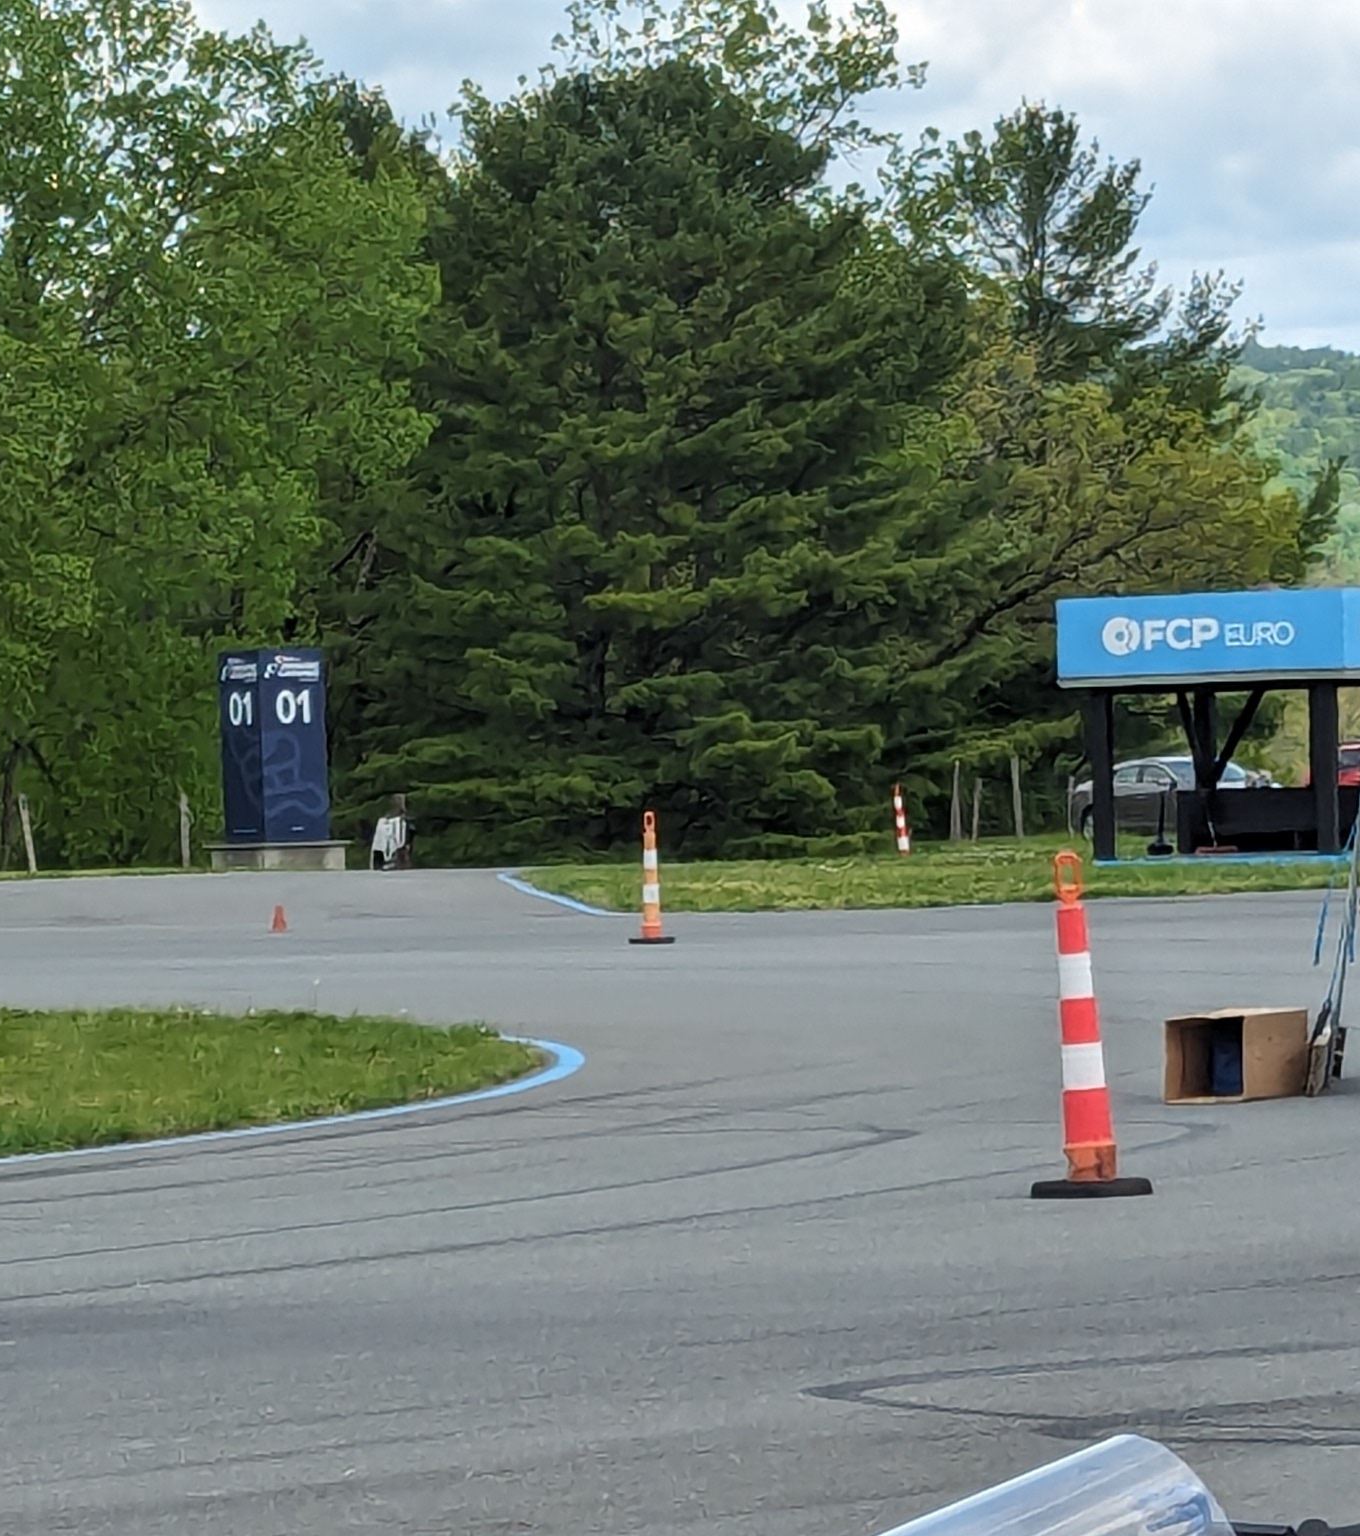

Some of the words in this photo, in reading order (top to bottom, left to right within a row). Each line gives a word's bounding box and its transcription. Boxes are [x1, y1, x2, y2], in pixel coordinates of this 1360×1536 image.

[1143, 618, 1219, 651] FCP
[1224, 621, 1295, 647] EURO
[229, 691, 252, 726] 01
[276, 689, 311, 724] 01
